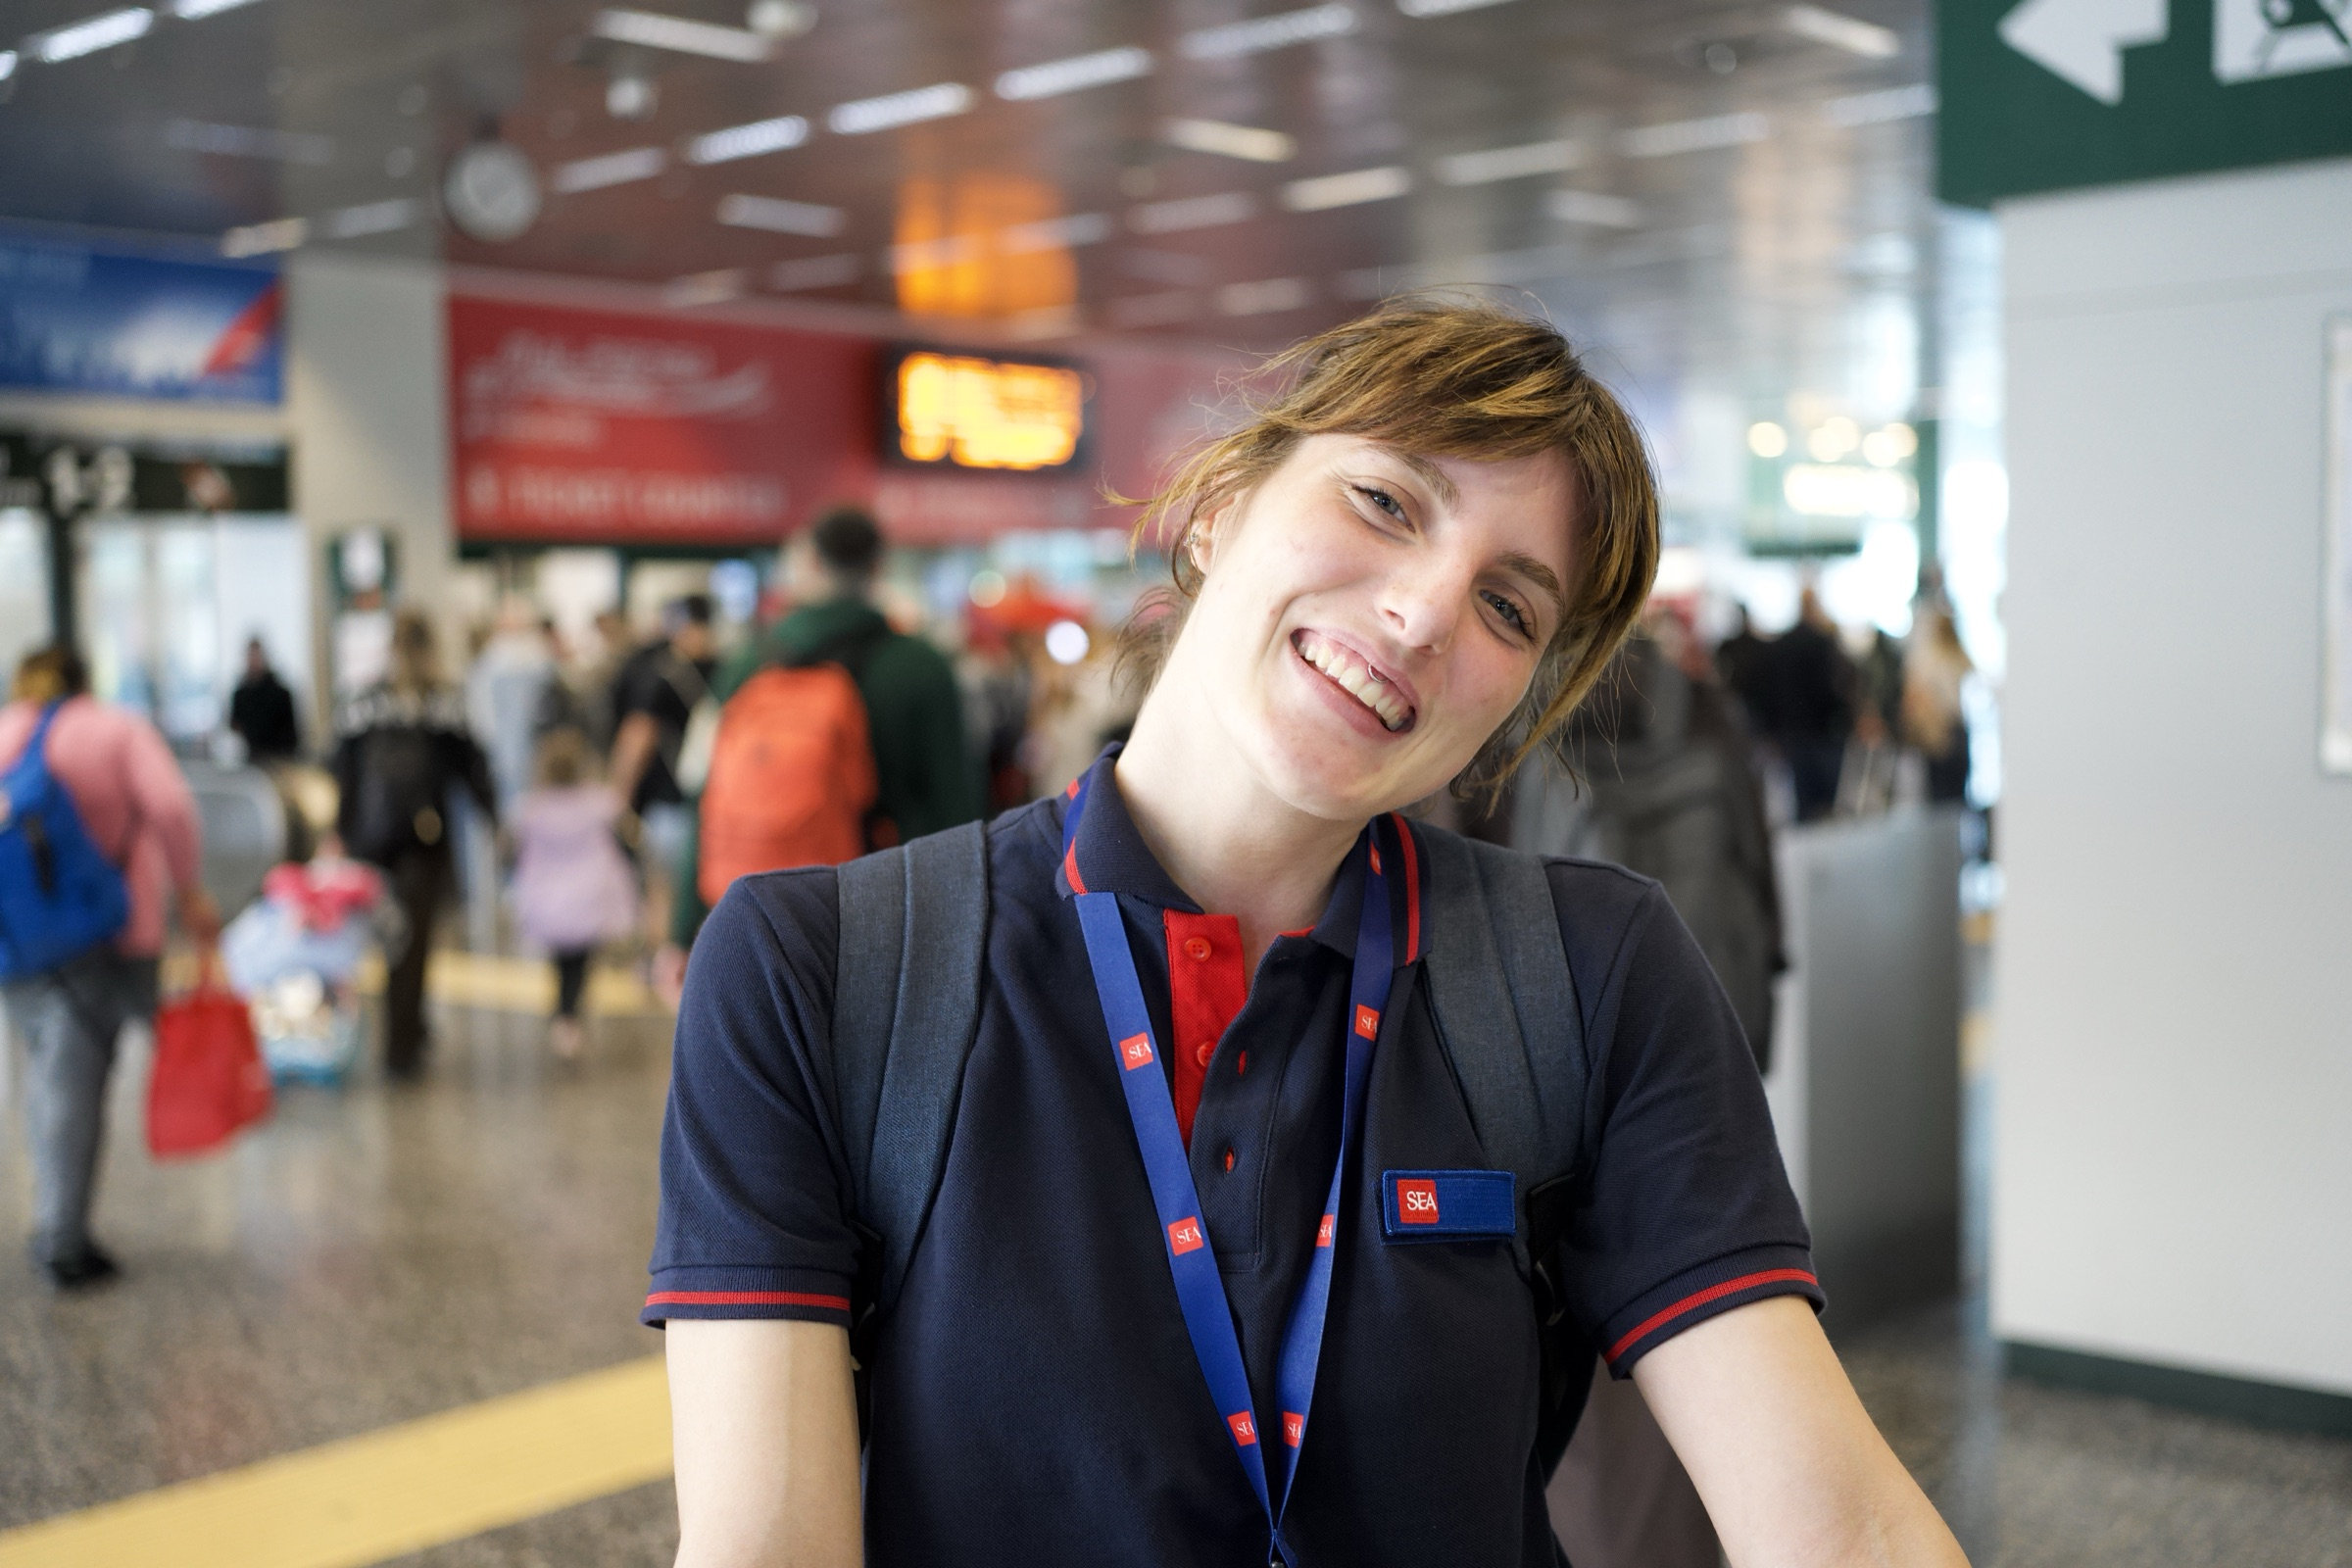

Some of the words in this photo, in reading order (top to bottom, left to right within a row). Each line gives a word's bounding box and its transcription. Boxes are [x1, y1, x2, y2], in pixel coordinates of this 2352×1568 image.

[1362, 1015, 1377, 1034] SEA
[1129, 1042, 1152, 1059] SEA
[1406, 1191, 1437, 1211] SEA
[1176, 1227, 1202, 1245] SEA
[1237, 1421, 1255, 1437] SEA
[1288, 1423, 1301, 1440] SEA
